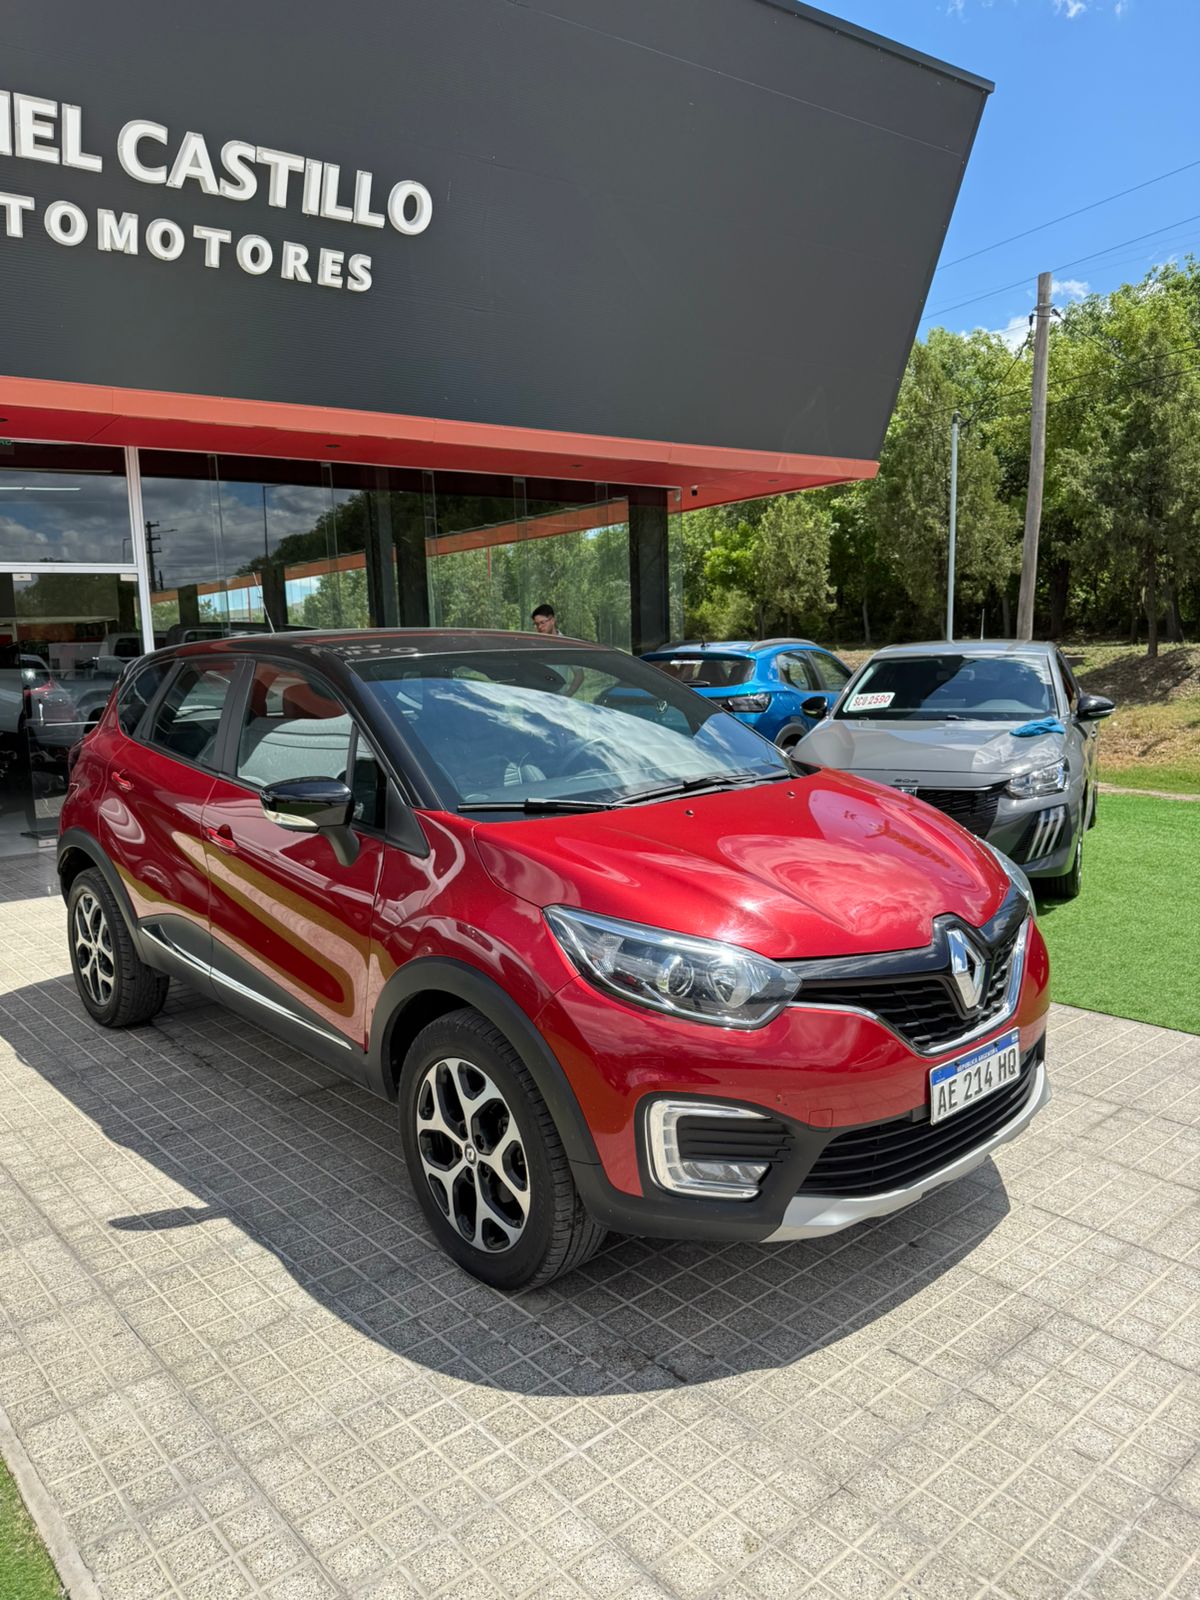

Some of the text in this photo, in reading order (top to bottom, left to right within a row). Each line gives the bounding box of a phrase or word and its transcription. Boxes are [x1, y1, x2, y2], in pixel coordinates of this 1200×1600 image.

[117, 119, 433, 236] CASTILLO
[0, 191, 373, 292] TOMOTORES
[937, 1048, 1017, 1116] AE 214 HQ
